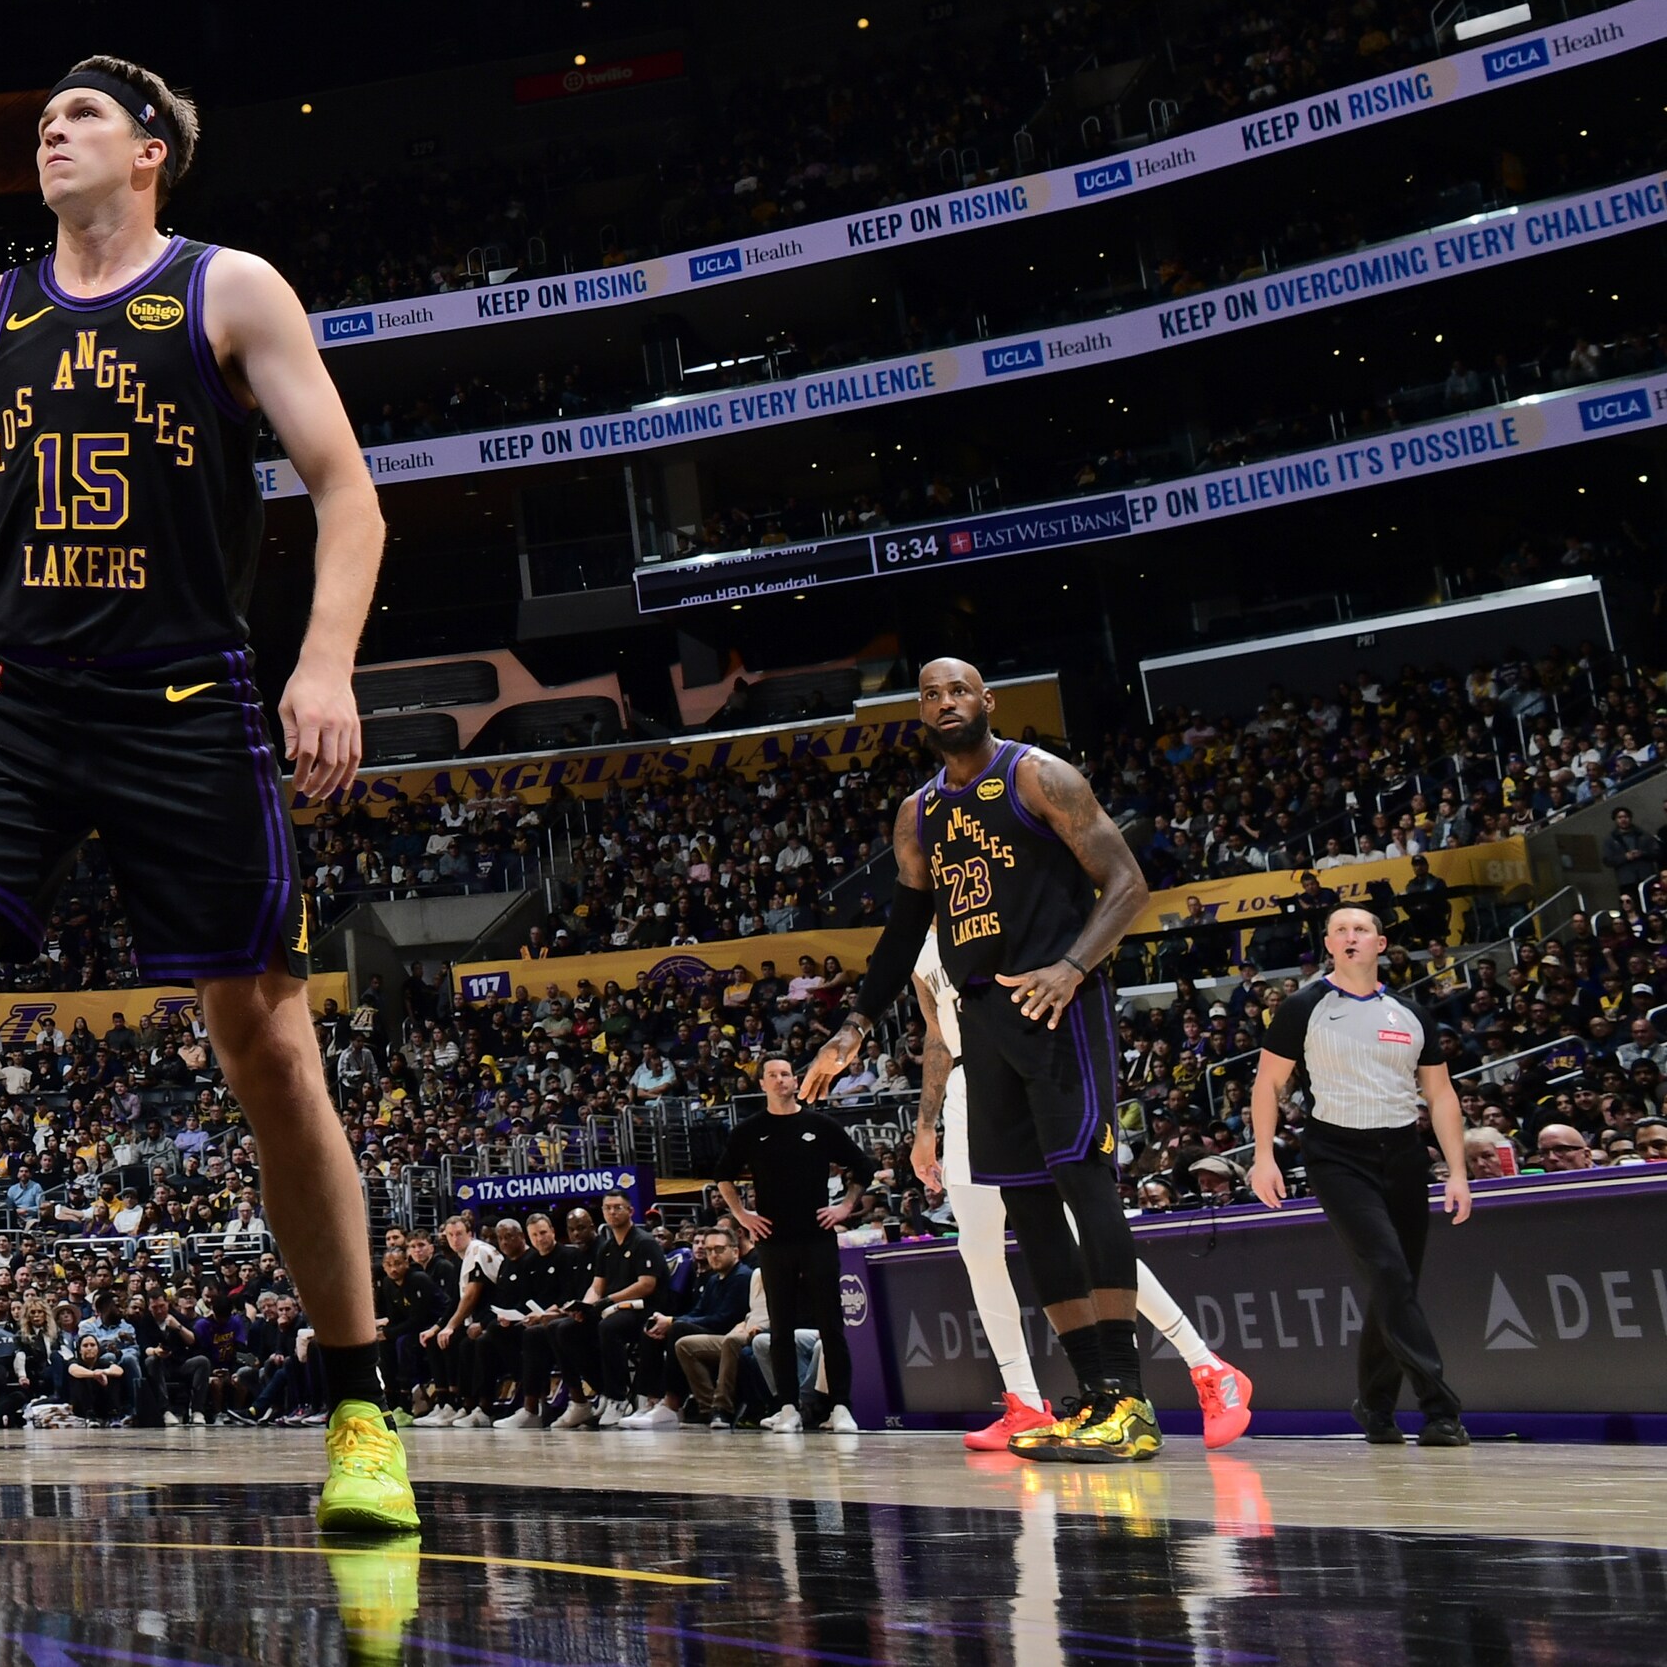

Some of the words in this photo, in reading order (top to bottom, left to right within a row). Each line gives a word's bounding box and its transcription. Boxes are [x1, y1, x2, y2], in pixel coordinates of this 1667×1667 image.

[1492, 49, 1539, 73] UCLA
[1553, 21, 1625, 58] Health
[1241, 113, 1300, 151] KEEP
[1308, 100, 1342, 129] ON
[1346, 74, 1433, 120] RISING
[476, 290, 532, 318] KEEP
[537, 285, 568, 309] ON
[575, 270, 647, 303] RISING
[1158, 302, 1216, 339] KEEP
[1225, 291, 1258, 322] ON
[1265, 248, 1428, 313] OVERCOMING
[1435, 224, 1517, 268] EVERY
[131, 303, 179, 320] bibigo
[52, 330, 195, 466] ANGELES
[479, 435, 533, 463] KEEP
[540, 429, 572, 453] ON
[579, 405, 722, 451] OVERCOMING
[730, 389, 797, 423] EVERY
[806, 363, 935, 409] CHALLENGE
[1589, 396, 1640, 422] UCLA
[34, 432, 129, 530] 15
[1166, 489, 1198, 516] ON
[1205, 459, 1329, 510] BELIEVING
[1337, 448, 1385, 480] IT'S
[1390, 417, 1520, 469] POSSIBLE
[23, 544, 147, 589] LAKERS
[885, 535, 939, 563] 8:34
[413, 744, 692, 799] ANGELES
[931, 842, 943, 889] LOS
[947, 807, 1015, 868] ANGELES
[941, 856, 992, 917] 23
[1236, 896, 1279, 913] LOS
[952, 912, 1001, 947] LAKERS
[469, 976, 501, 997] 117
[477, 1182, 504, 1199] 17x
[506, 1172, 613, 1197] CHAMPIONS
[1200, 1287, 1362, 1352] DELTA
